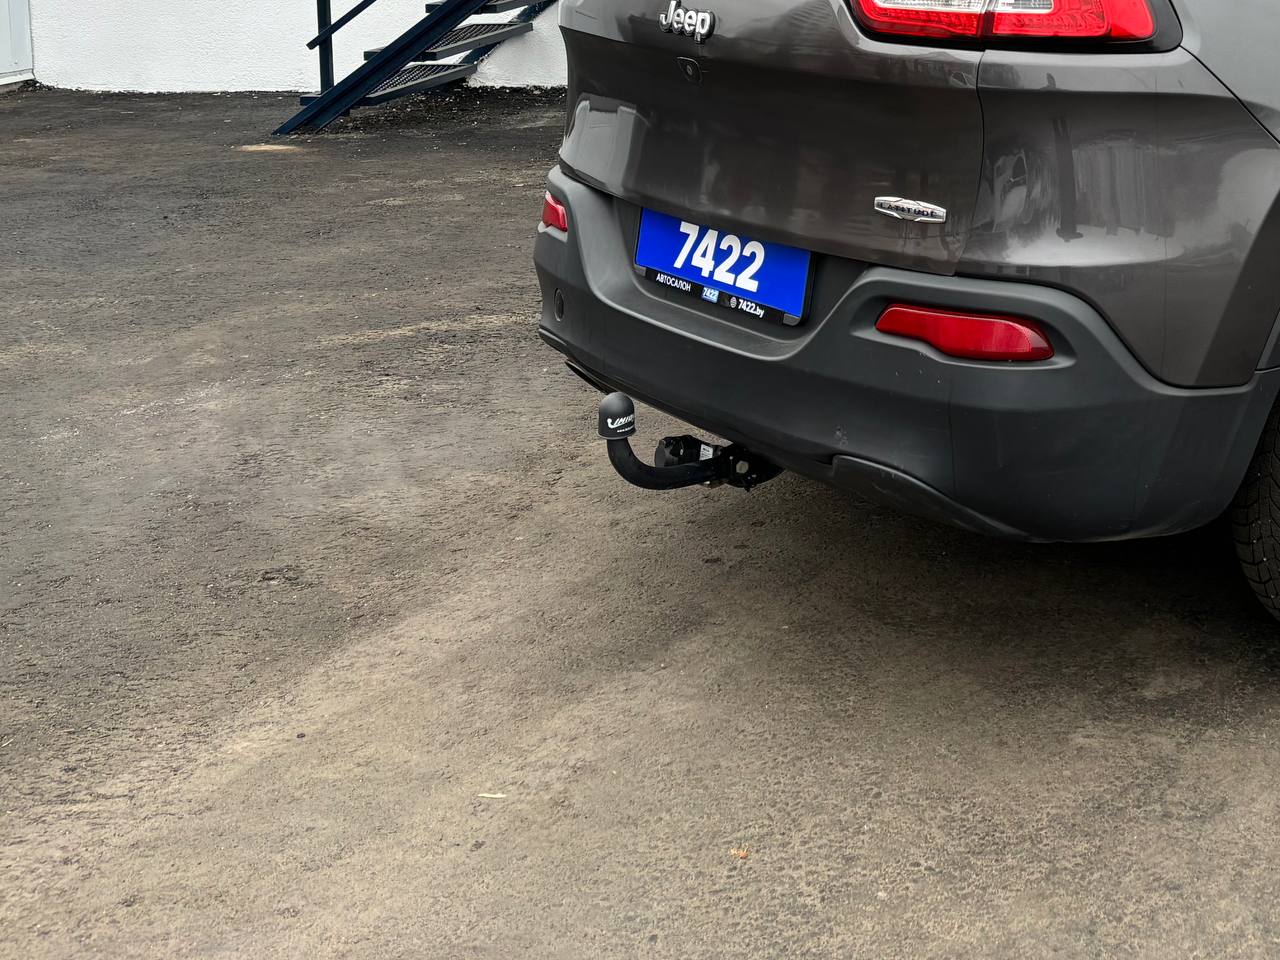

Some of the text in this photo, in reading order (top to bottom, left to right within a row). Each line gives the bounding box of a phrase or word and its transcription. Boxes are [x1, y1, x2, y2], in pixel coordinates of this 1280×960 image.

[659, 0, 712, 42] Jeep
[879, 202, 938, 218] LATITUDE
[673, 221, 765, 293] 7422
[656, 273, 692, 292] АВТОСАЛОН
[703, 287, 718, 300] 7422
[738, 298, 765, 318] 7422.by
